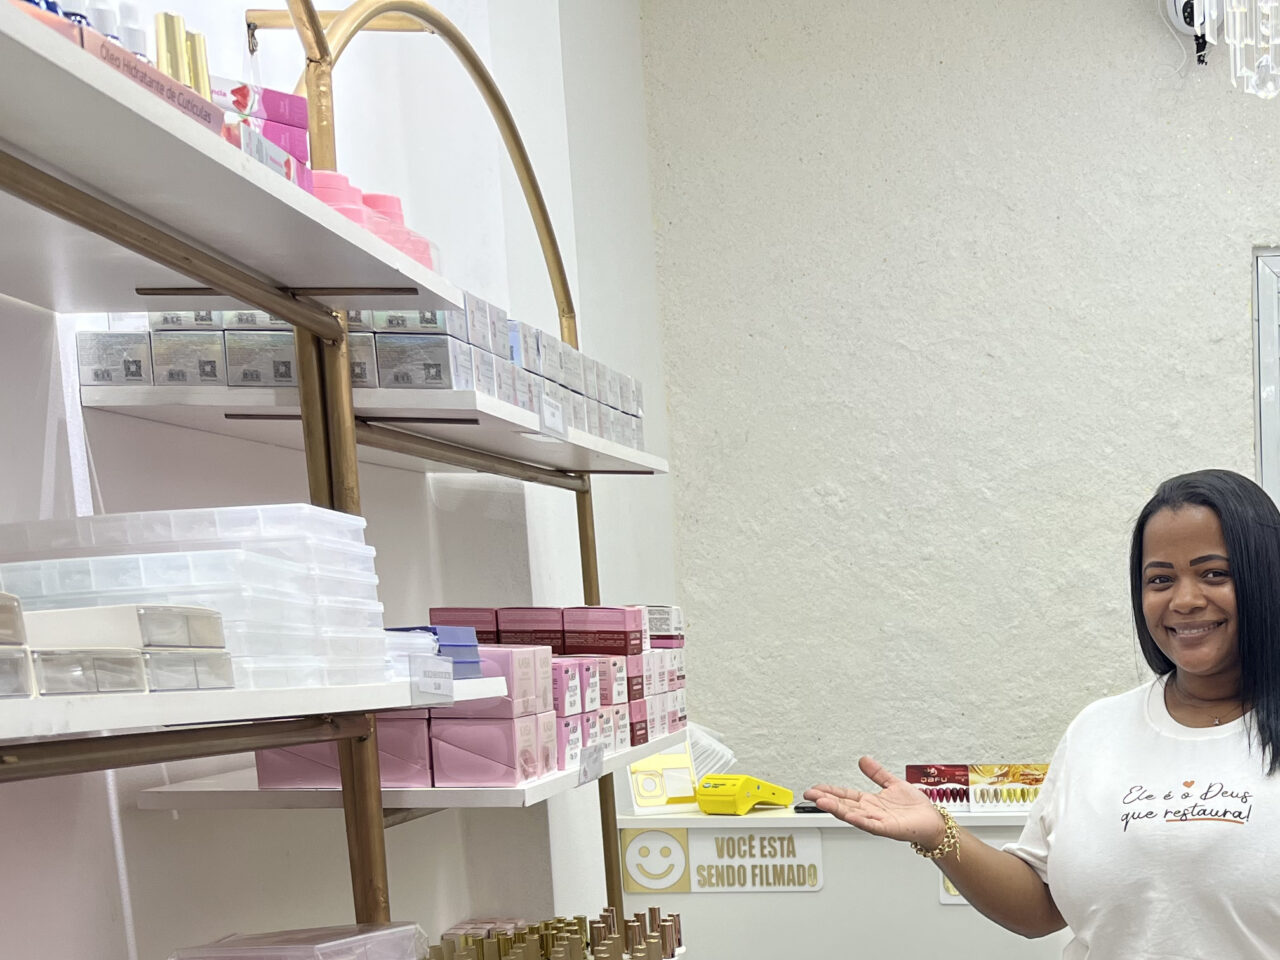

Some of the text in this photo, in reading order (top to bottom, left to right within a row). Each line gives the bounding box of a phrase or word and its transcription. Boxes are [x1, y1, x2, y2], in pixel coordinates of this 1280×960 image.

[122, 57, 166, 96] Hidratante
[166, 87, 177, 102] de
[1123, 782, 1253, 804] Ele é o Deus
[1121, 803, 1252, 832] que restaura!
[715, 833, 797, 859] VOCÊ ESTÁ
[697, 864, 818, 888] SENDO FILMADO
